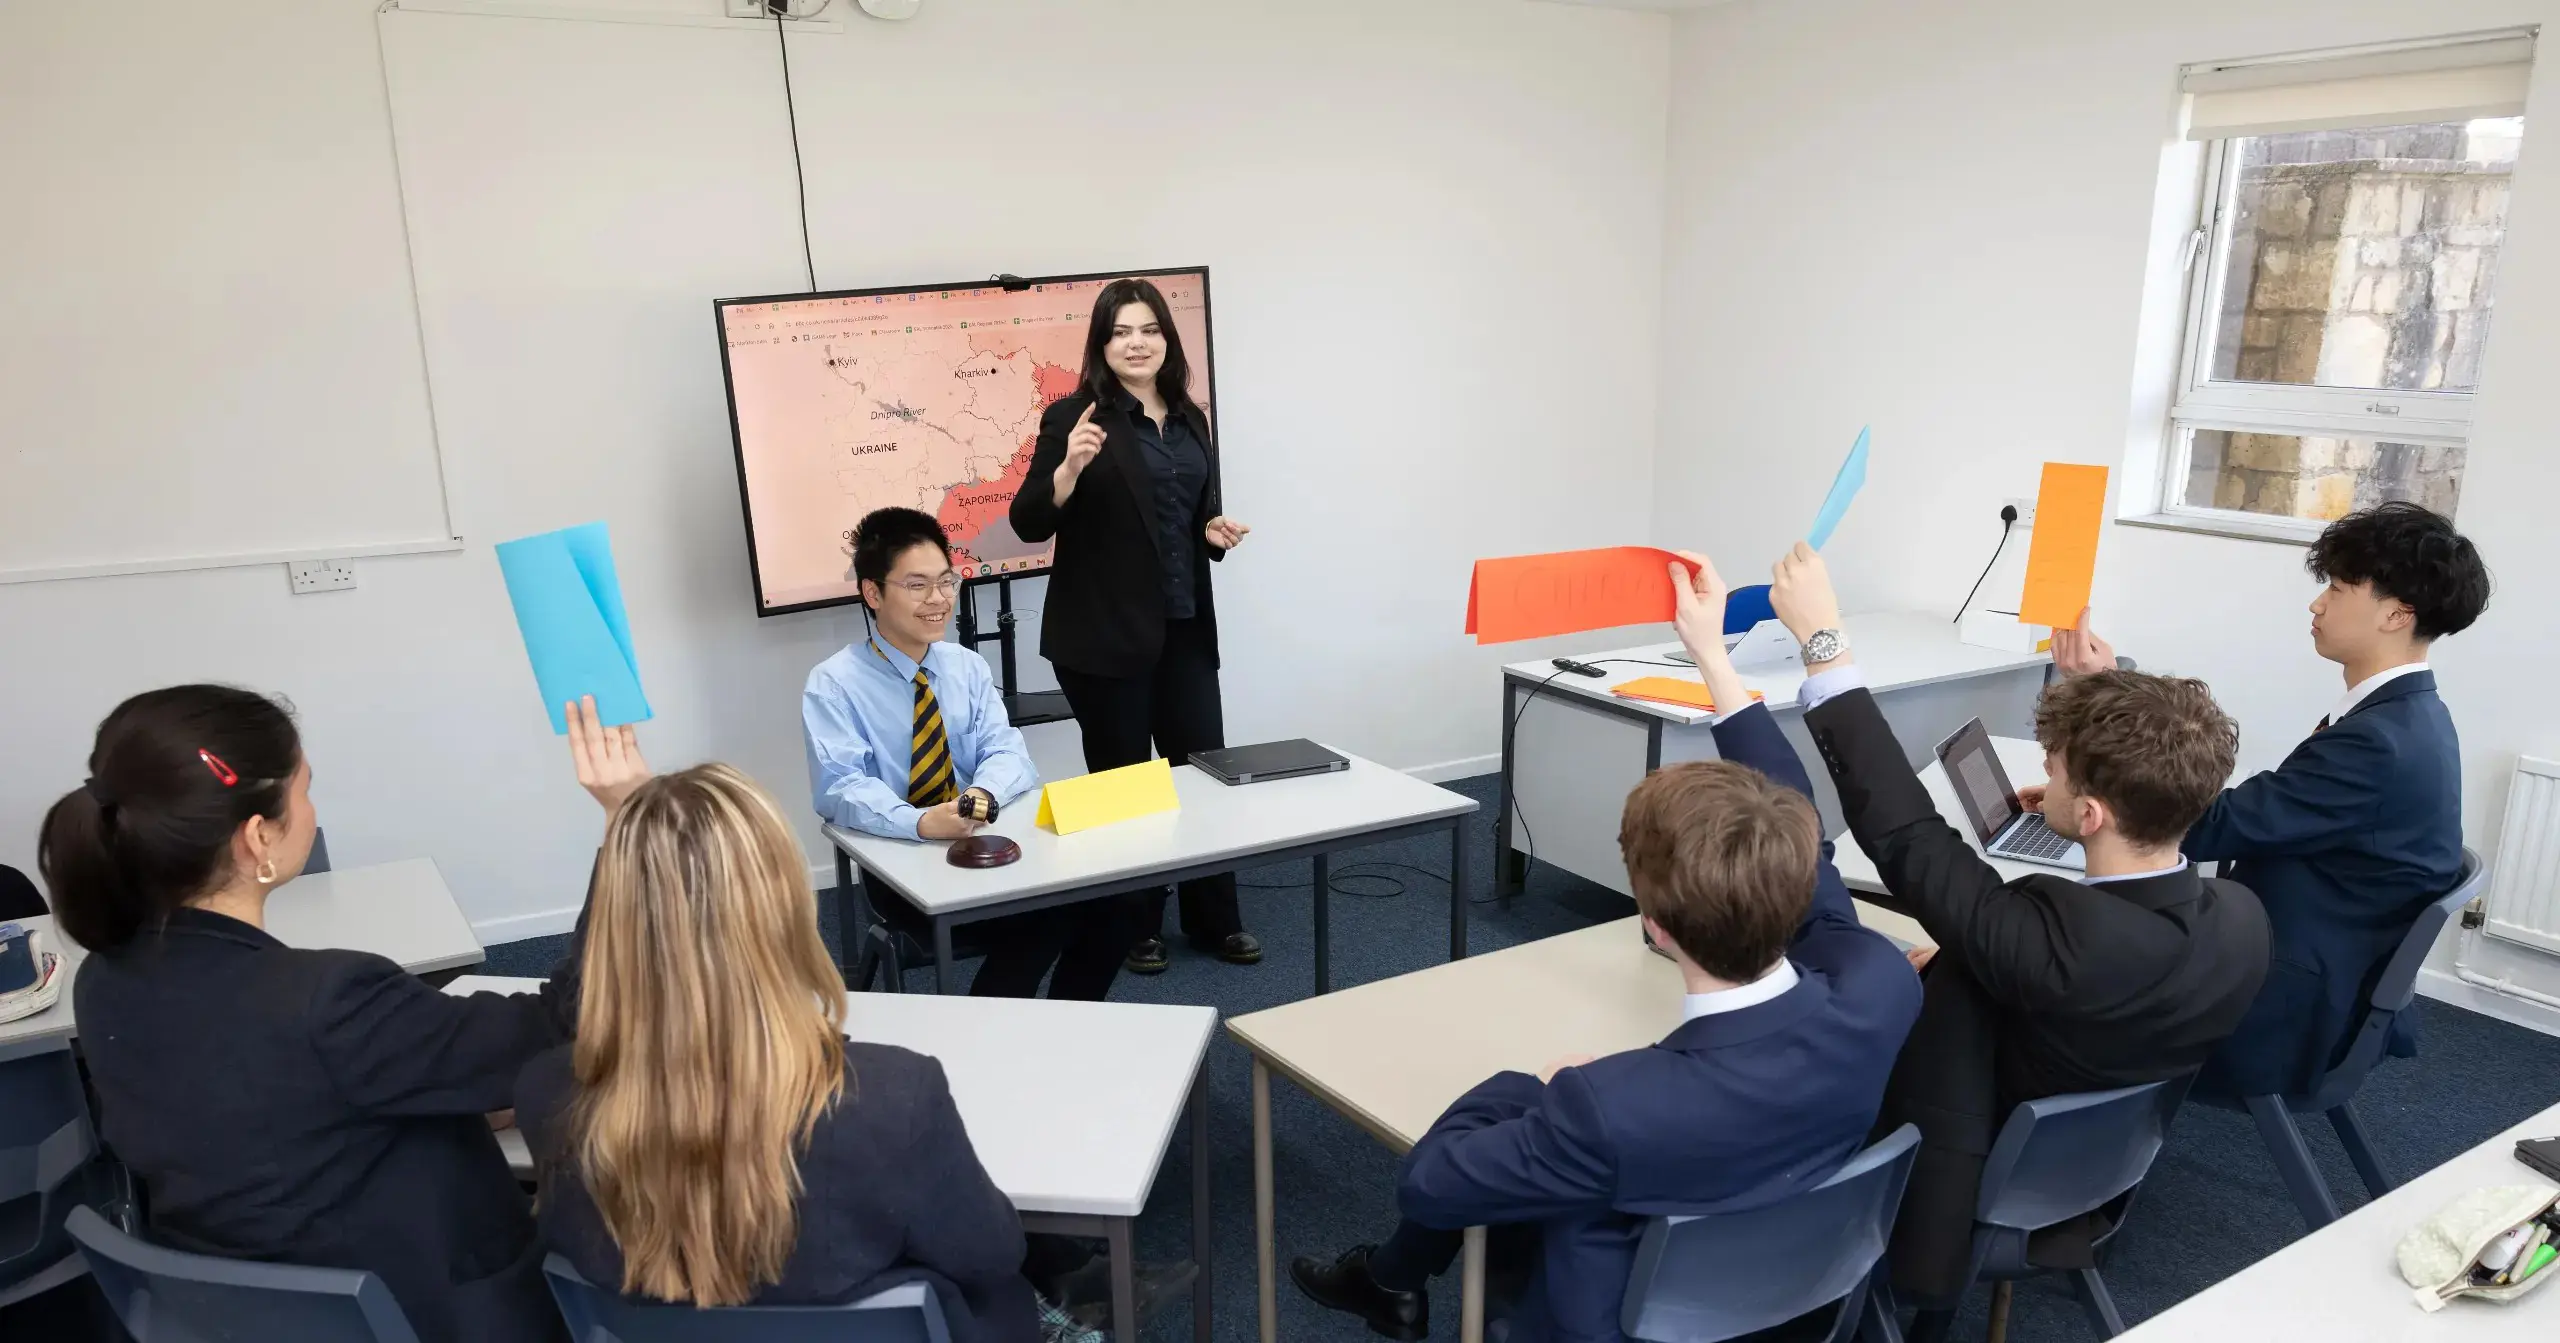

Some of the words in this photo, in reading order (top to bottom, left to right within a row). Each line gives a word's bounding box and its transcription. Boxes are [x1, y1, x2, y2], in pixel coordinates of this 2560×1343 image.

[837, 356, 858, 368] Kyiv
[954, 368, 989, 379] Kharkiv
[870, 410, 901, 421] Dnipro
[903, 407, 926, 417] River
[851, 442, 898, 456] UKRAINE
